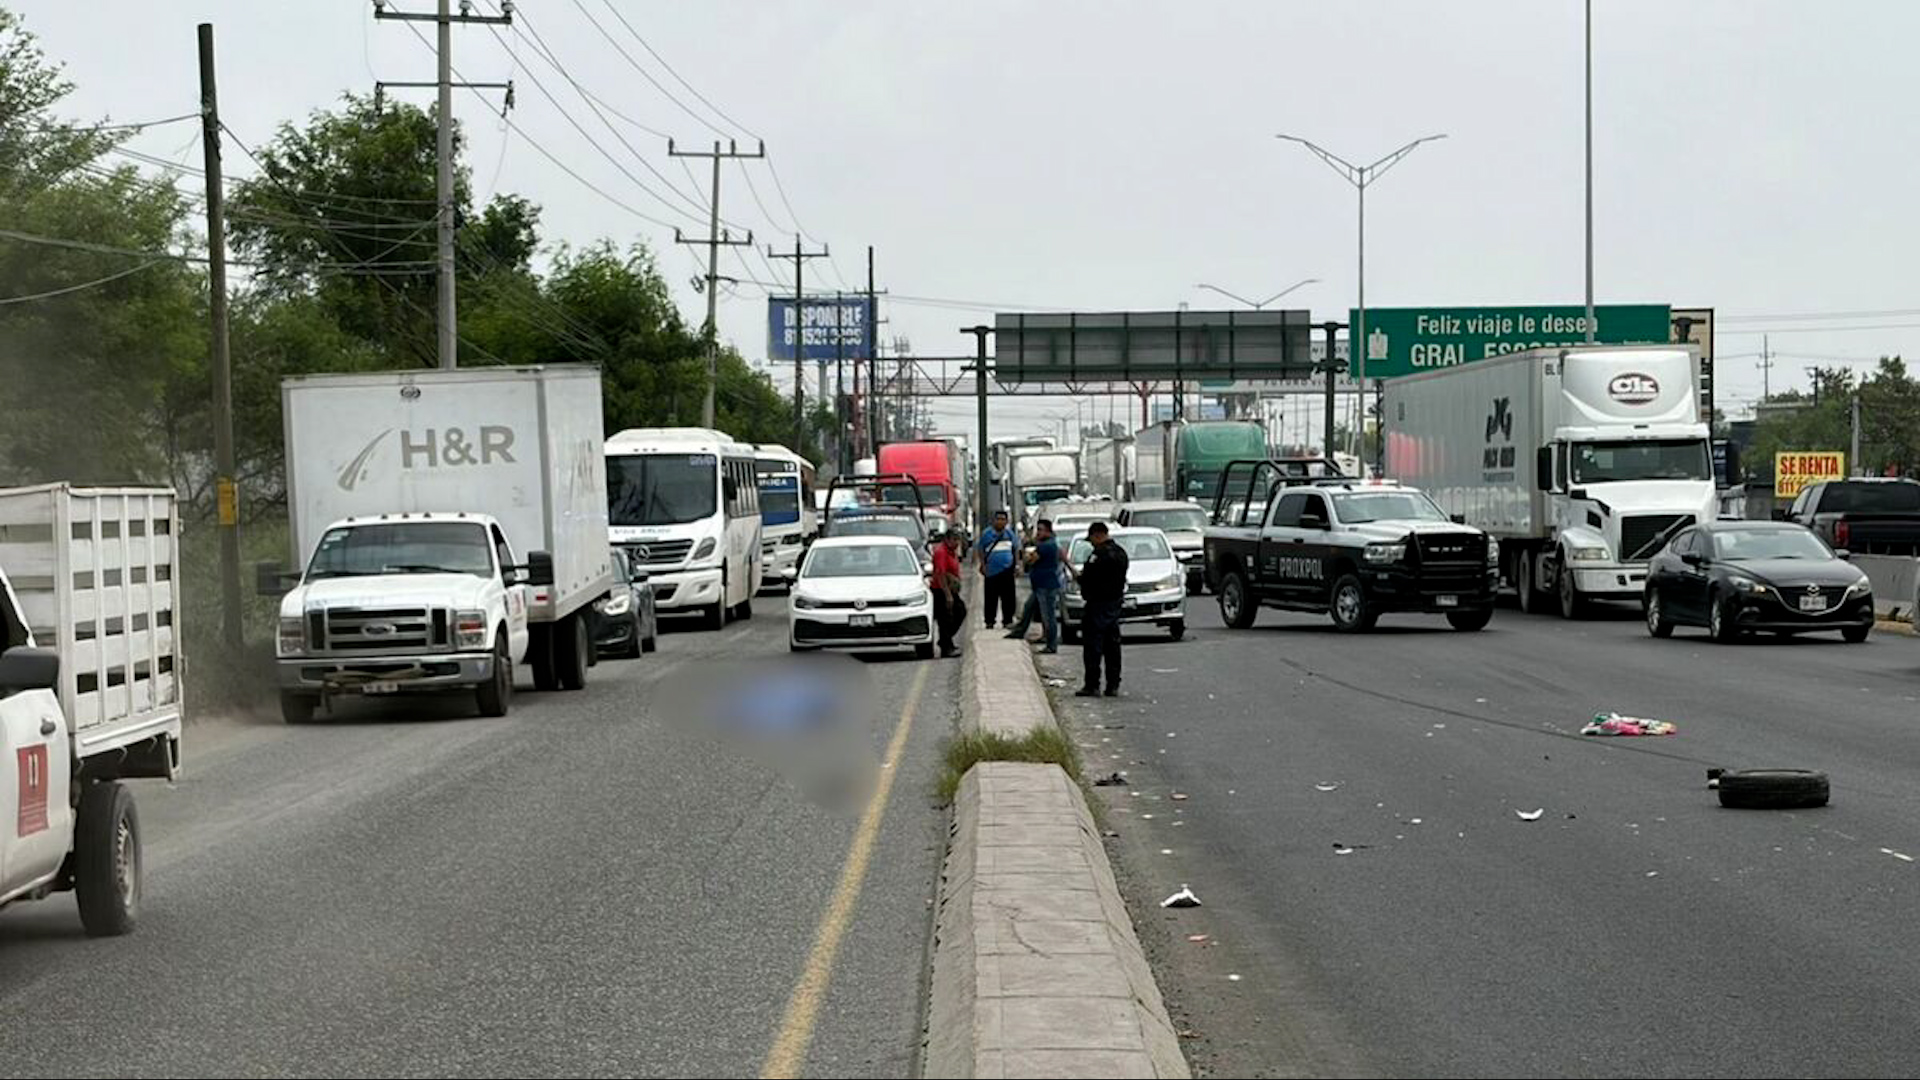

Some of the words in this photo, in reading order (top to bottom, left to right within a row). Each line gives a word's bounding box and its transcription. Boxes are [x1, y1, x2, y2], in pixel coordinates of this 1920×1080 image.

[1417, 315, 1461, 335] Feliz
[1467, 314, 1513, 337] viaje
[1519, 314, 1536, 334] le
[401, 425, 517, 469] H&R
[1780, 456, 1796, 475] SE
[1798, 456, 1839, 476] RENTA
[1279, 557, 1325, 580] PROXPOL
